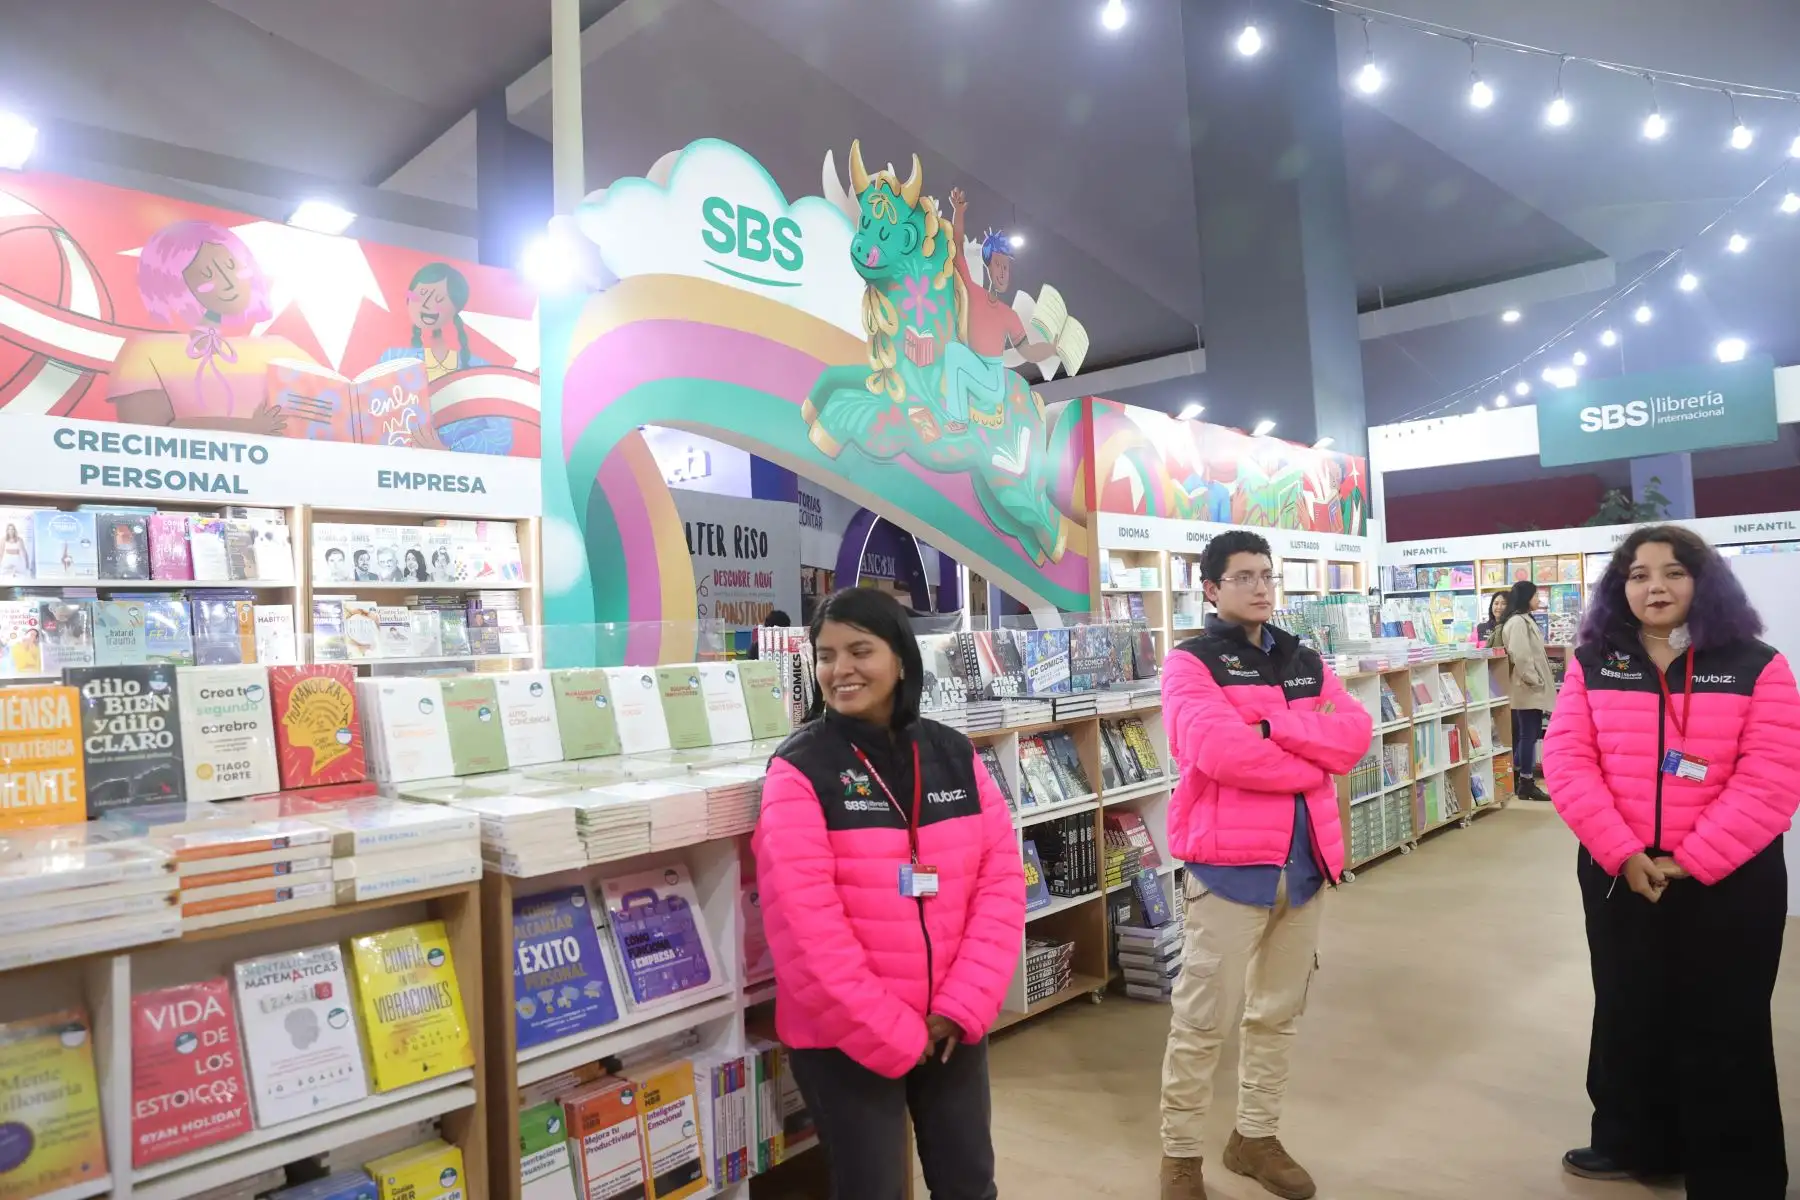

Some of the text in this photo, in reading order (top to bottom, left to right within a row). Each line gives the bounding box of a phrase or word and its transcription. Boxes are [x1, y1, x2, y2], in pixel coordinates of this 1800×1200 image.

[701, 196, 804, 272] SBS
[1580, 390, 1724, 432] SBS librería
[1657, 407, 1725, 424] internacional
[54, 428, 269, 465] CRECIMIENTO
[80, 463, 249, 495] PERSONAL
[377, 470, 487, 494] EMPRESA
[798, 491, 821, 513] TORIAS
[1118, 527, 1150, 539] IDIOMAS
[1186, 532, 1213, 542] IDIOMAS
[1734, 521, 1797, 533] INFANTIL
[685, 521, 727, 558] LTER
[1290, 540, 1320, 551] ILUSTRADOS
[1335, 542, 1361, 553] ILUSTRADOS
[1502, 539, 1552, 550] INFANTIL
[1402, 546, 1448, 557] INFANTIL
[714, 569, 751, 590] DESCUBRE
[793, 653, 803, 701] COMICS
[1029, 667, 1040, 678] DC
[1040, 655, 1064, 671] COMICS
[1600, 667, 1621, 679] SBS
[82, 678, 141, 698] dilo
[991, 675, 1018, 689] STAR
[992, 686, 1019, 698] WARS
[199, 686, 235, 700] Crea
[0, 694, 73, 732] IENSA
[103, 695, 171, 716] BIEN
[196, 701, 259, 717] segundo
[85, 731, 174, 755] CLARO
[215, 761, 251, 772] TIAGO
[217, 772, 252, 783] FORTE
[844, 799, 868, 811] SBS
[518, 935, 581, 975] ÉXITO
[635, 948, 677, 969] EMPRESA
[373, 980, 453, 1024] VIBRACIONES
[144, 996, 226, 1032] VIDA
[203, 1026, 230, 1047] DE
[195, 1051, 234, 1076] LOS
[135, 1076, 239, 1119] ESTOICOS
[647, 1099, 686, 1121] Inteligencia
[647, 1109, 684, 1131] Emocional
[139, 1107, 242, 1146] RYAN HOLIDAY
[584, 1126, 620, 1146] Mejora tu
[586, 1129, 637, 1155] Productividad
